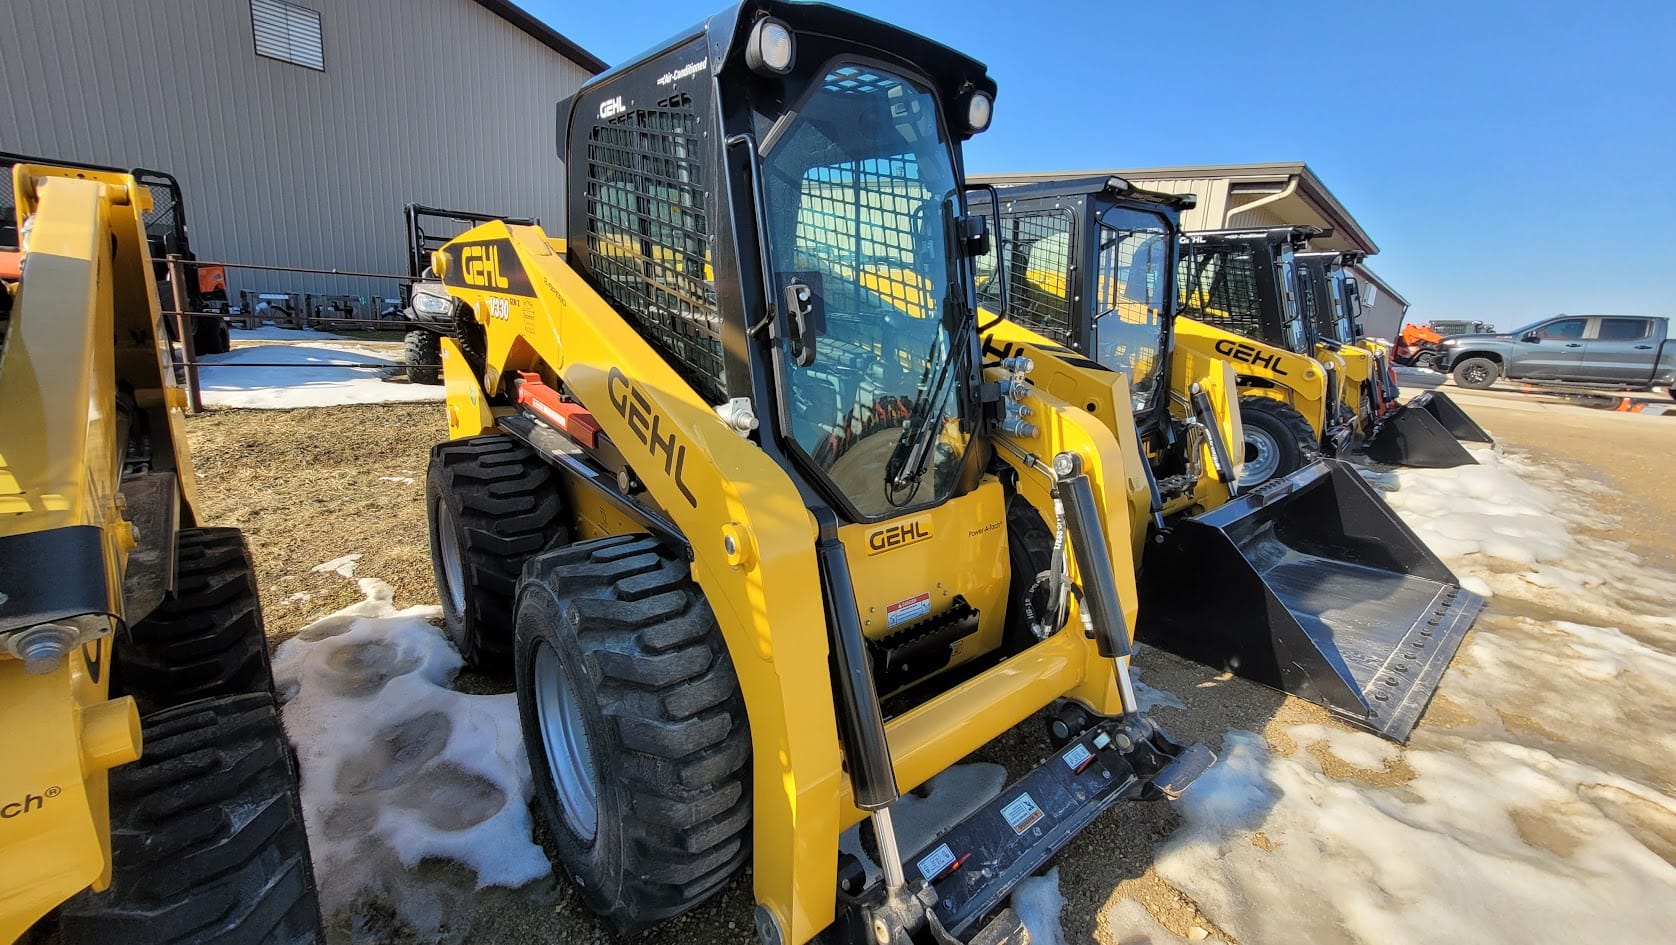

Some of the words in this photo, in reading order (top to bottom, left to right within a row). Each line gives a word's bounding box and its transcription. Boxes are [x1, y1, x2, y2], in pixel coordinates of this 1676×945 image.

[599, 95, 626, 119] GEHL
[461, 245, 509, 289] GEHL
[1214, 339, 1288, 376] GEHL
[607, 366, 698, 509] GEHL
[869, 520, 929, 551] GEHL
